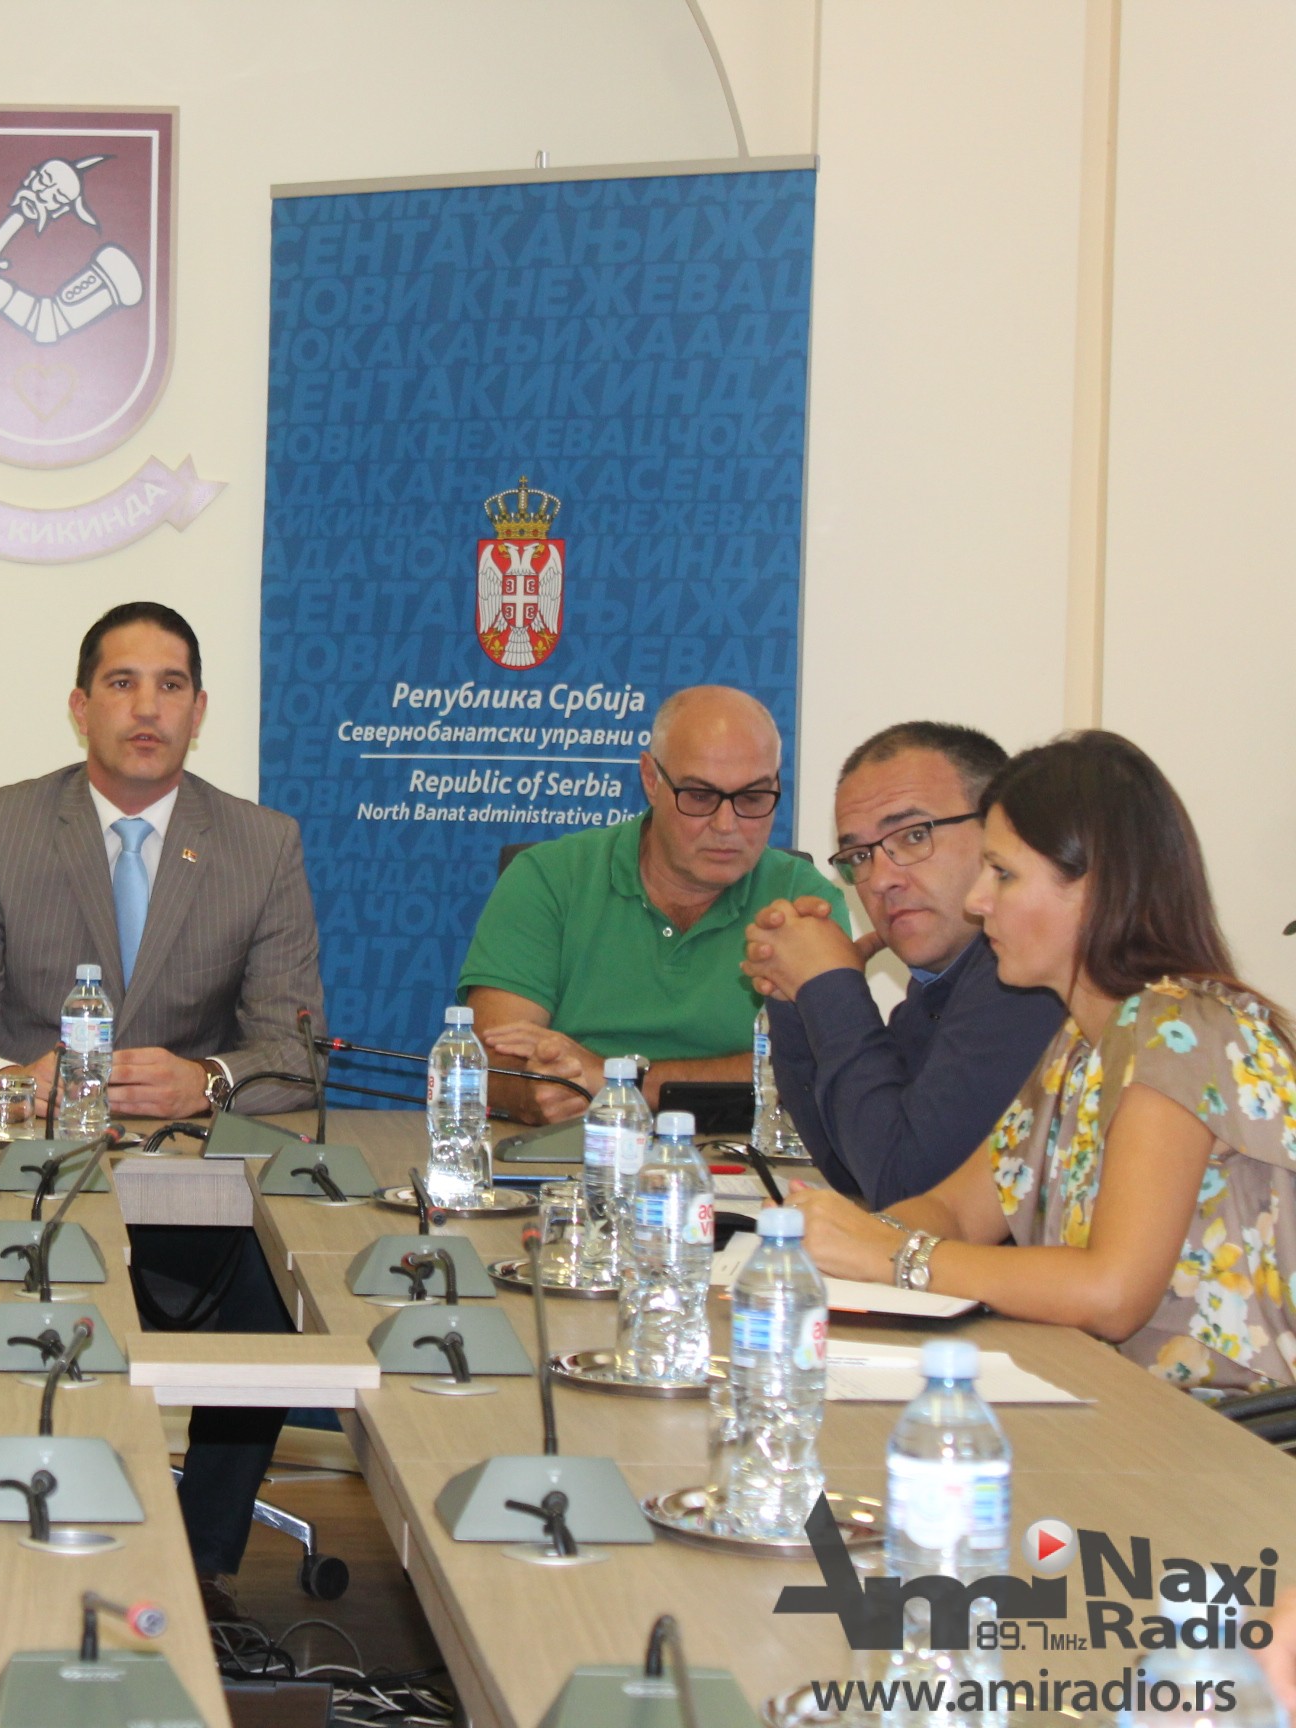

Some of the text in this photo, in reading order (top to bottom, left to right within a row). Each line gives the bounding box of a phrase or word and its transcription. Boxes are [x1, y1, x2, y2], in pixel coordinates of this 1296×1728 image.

[7, 481, 168, 545] КИКИНДА
[392, 681, 542, 717] Република
[548, 683, 645, 720] Србија
[338, 721, 652, 750] Севернобанатски управни о
[409, 768, 511, 800] Republic
[516, 771, 544, 801] of
[545, 772, 622, 798] Serbia
[357, 802, 644, 826] North Banat administrative Dis
